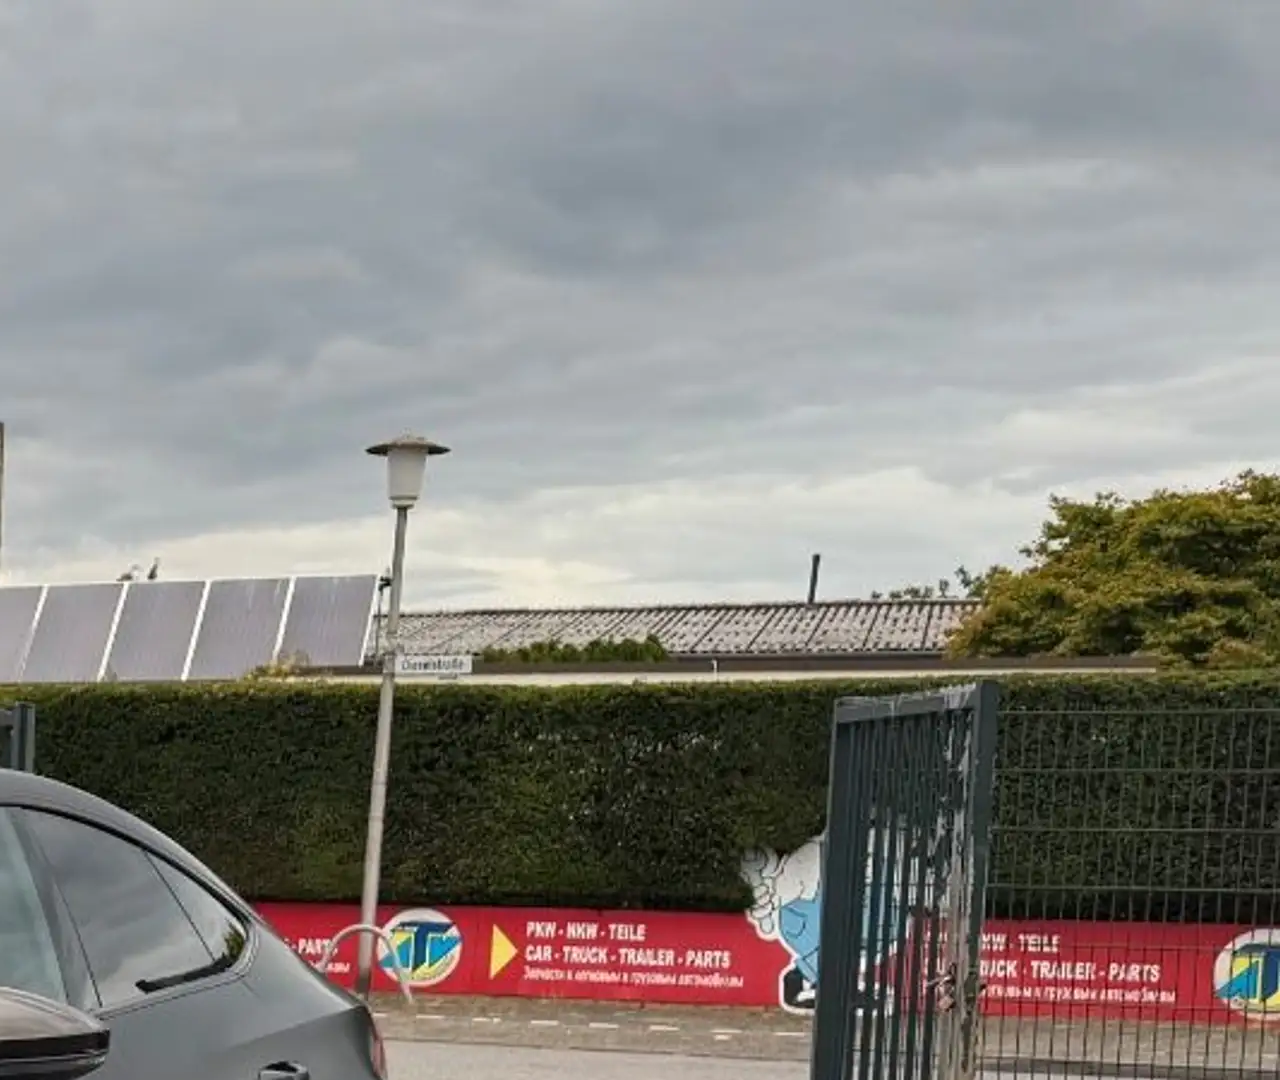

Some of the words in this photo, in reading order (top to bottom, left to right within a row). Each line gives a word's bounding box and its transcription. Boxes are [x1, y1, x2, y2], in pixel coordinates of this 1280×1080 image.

[526, 921, 556, 939] PKW
[608, 924, 647, 942] TEILE
[525, 944, 552, 961] CAR
[562, 945, 607, 964] TRUCK
[618, 947, 675, 966] TRAILER
[685, 949, 731, 968] PARTS
[1030, 960, 1097, 980] TRAILER
[1108, 962, 1161, 982] PARTS
